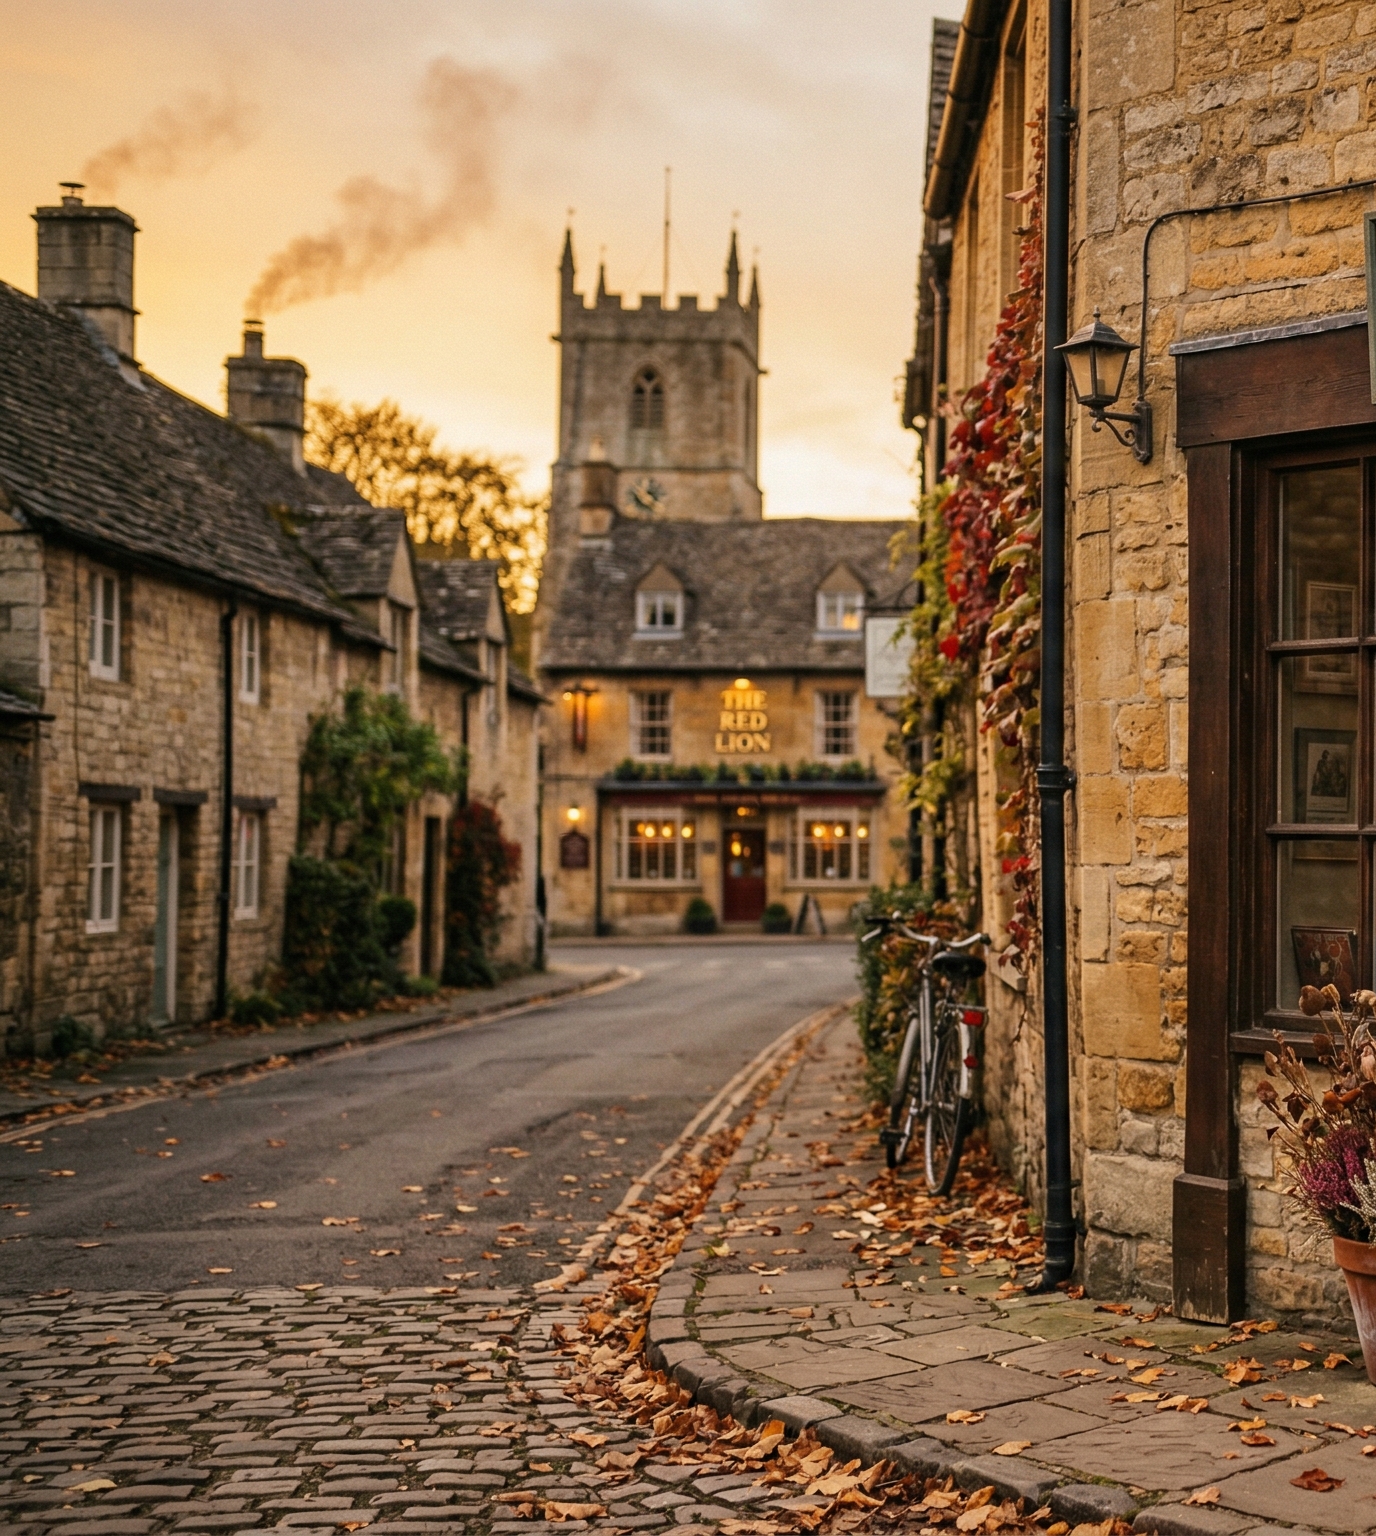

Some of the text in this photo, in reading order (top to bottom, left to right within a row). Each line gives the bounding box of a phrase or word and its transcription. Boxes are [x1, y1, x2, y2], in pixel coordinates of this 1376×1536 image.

[720, 690, 768, 710] THE
[720, 710, 768, 731] RED
[715, 732, 771, 753] LION
